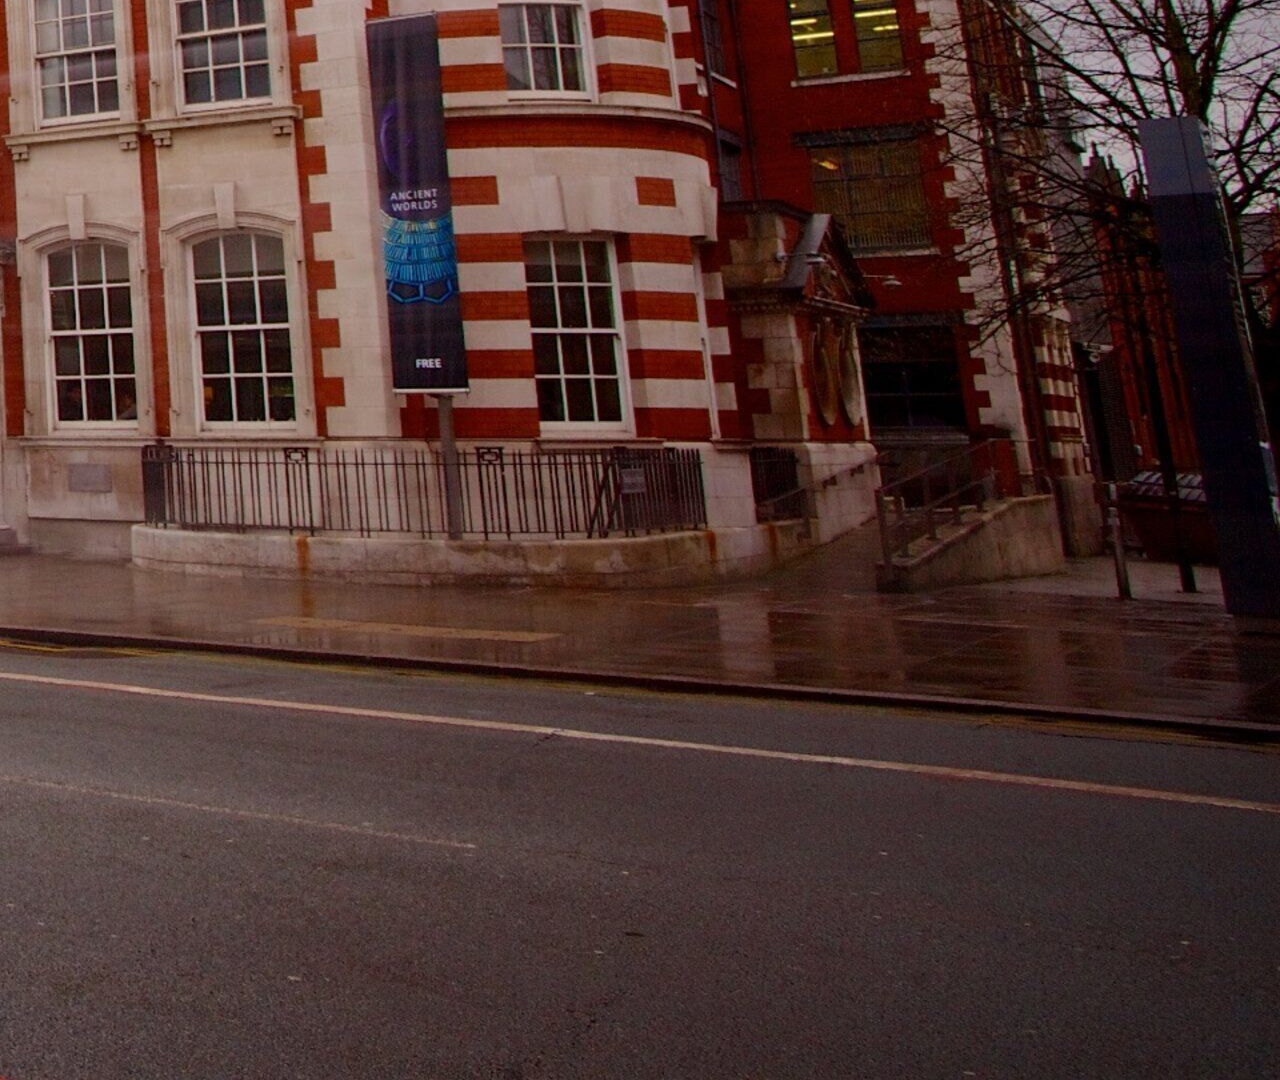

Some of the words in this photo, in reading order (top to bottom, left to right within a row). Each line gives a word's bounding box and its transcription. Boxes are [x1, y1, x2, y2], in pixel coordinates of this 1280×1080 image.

[390, 188, 438, 200] ANCIENT
[391, 199, 438, 211] WORLDS
[415, 358, 442, 368] FREE
